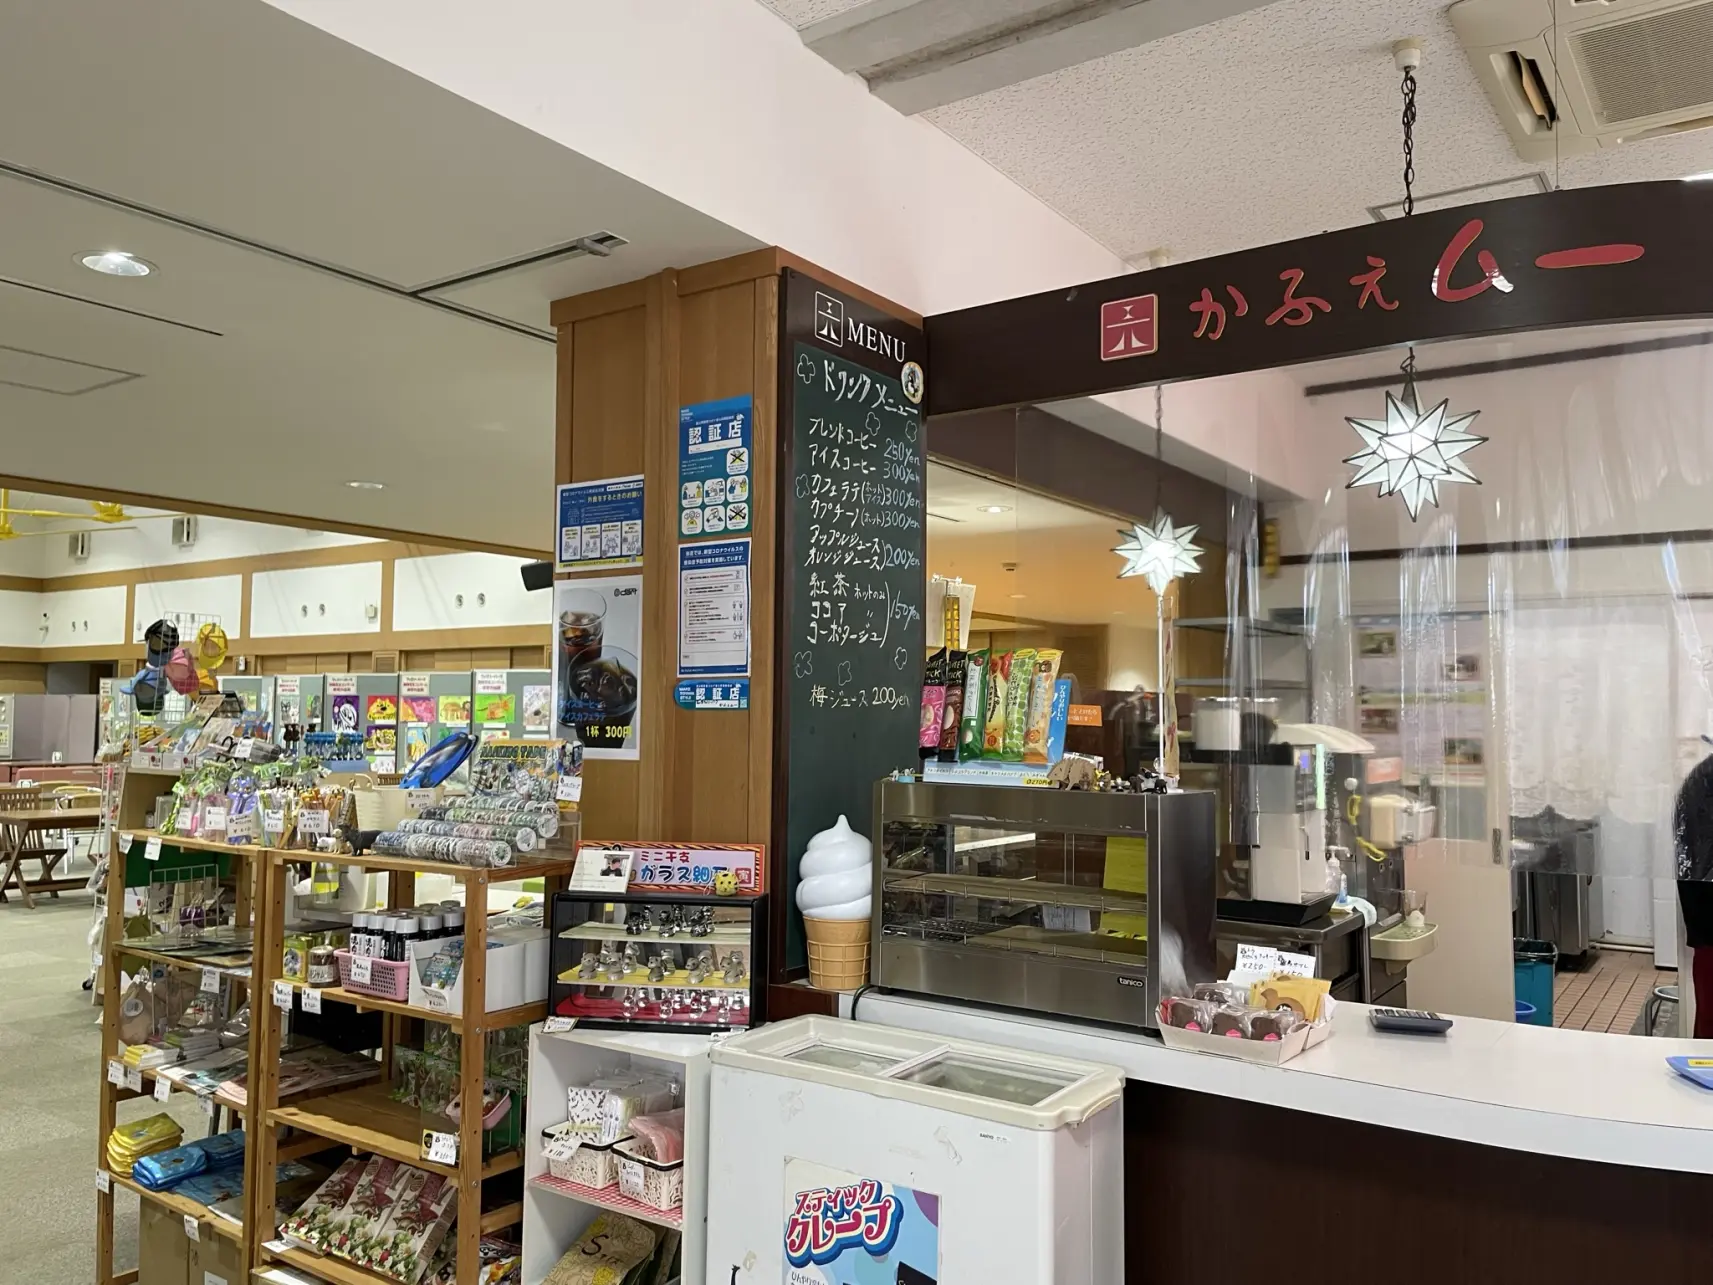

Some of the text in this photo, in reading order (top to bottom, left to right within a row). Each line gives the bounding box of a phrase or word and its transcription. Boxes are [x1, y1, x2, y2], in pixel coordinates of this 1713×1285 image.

[847, 316, 906, 363] MENU
[688, 420, 742, 445] 認証店
[808, 443, 877, 474] アイスコーヒー
[809, 572, 850, 597] 紅茶
[811, 601, 846, 624] ココア
[695, 686, 740, 701] 認証店
[810, 684, 868, 708] 梅ジュース
[586, 726, 632, 738] 1杯 300円
[640, 850, 690, 863] ミニ干支
[1119, 977, 1143, 988] tanico
[795, 1180, 877, 1216] スティック
[786, 1197, 896, 1255] クレープ
